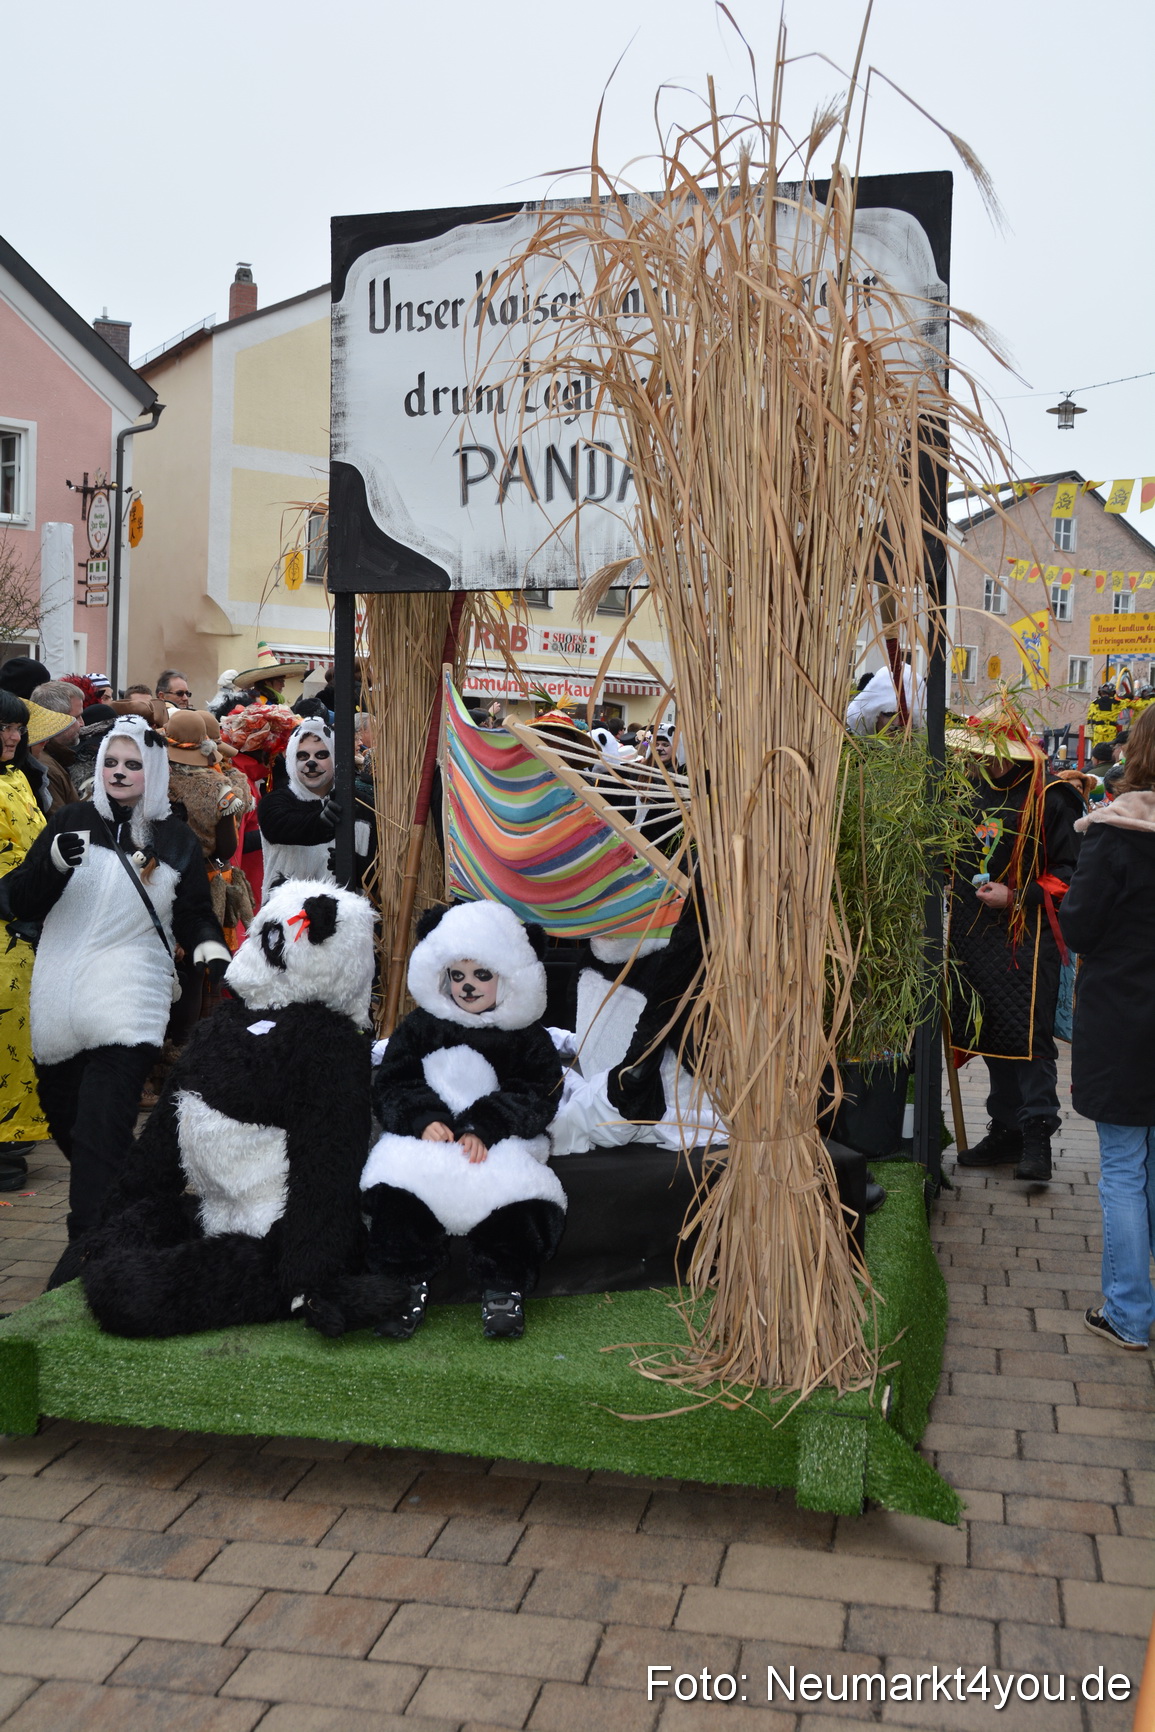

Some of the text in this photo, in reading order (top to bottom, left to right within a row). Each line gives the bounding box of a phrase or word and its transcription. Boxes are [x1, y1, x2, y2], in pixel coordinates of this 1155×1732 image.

[368, 276, 466, 334] Unser
[473, 269, 585, 328] Kaiser
[404, 370, 507, 418] drum
[560, 642, 588, 654] MORE
